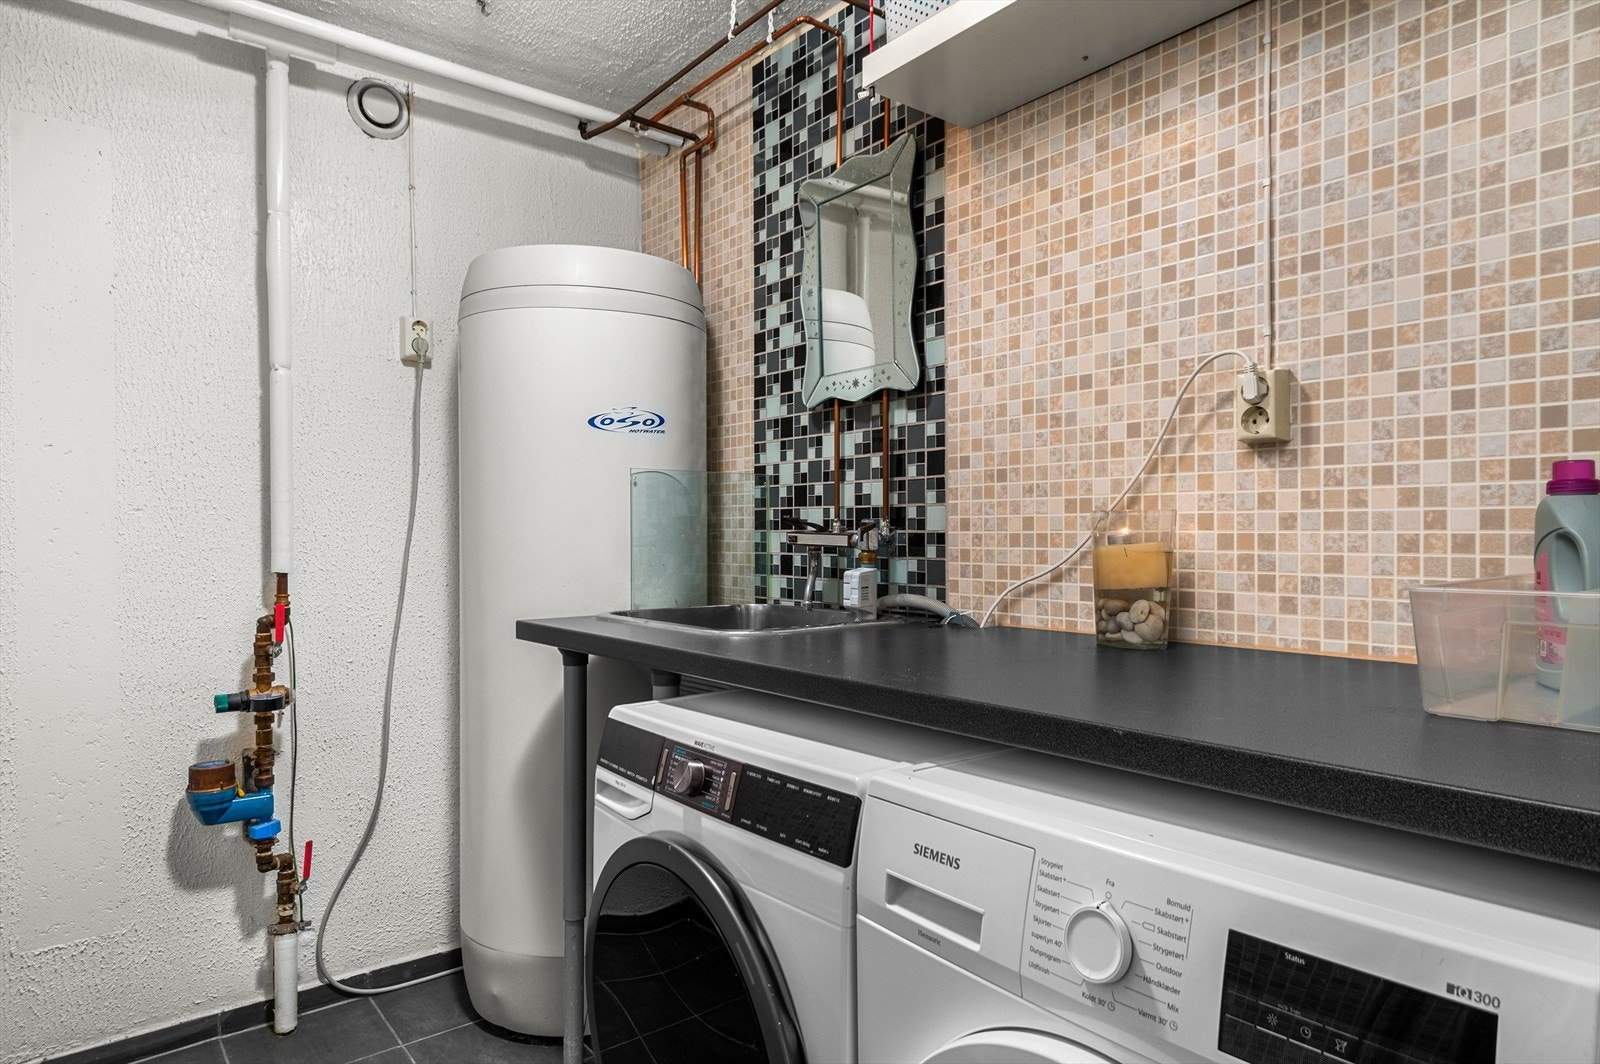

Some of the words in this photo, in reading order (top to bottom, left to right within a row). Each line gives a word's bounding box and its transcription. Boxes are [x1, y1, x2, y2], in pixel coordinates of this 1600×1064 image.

[913, 842, 961, 870] SIEMENS
[1105, 878, 1115, 888] Fra
[1166, 897, 1191, 912] Bomuld
[1033, 915, 1052, 928] Skjorter
[1156, 926, 1187, 943] Skabstørt
[1152, 942, 1185, 961] Strygetørt
[1284, 951, 1305, 965] Status
[1028, 960, 1050, 976] Uldfinish
[1155, 962, 1183, 978] Outdoor
[1142, 974, 1181, 996] Håndklæder
[1137, 1008, 1157, 1022] Varmt
[1167, 1002, 1180, 1013] Mix
